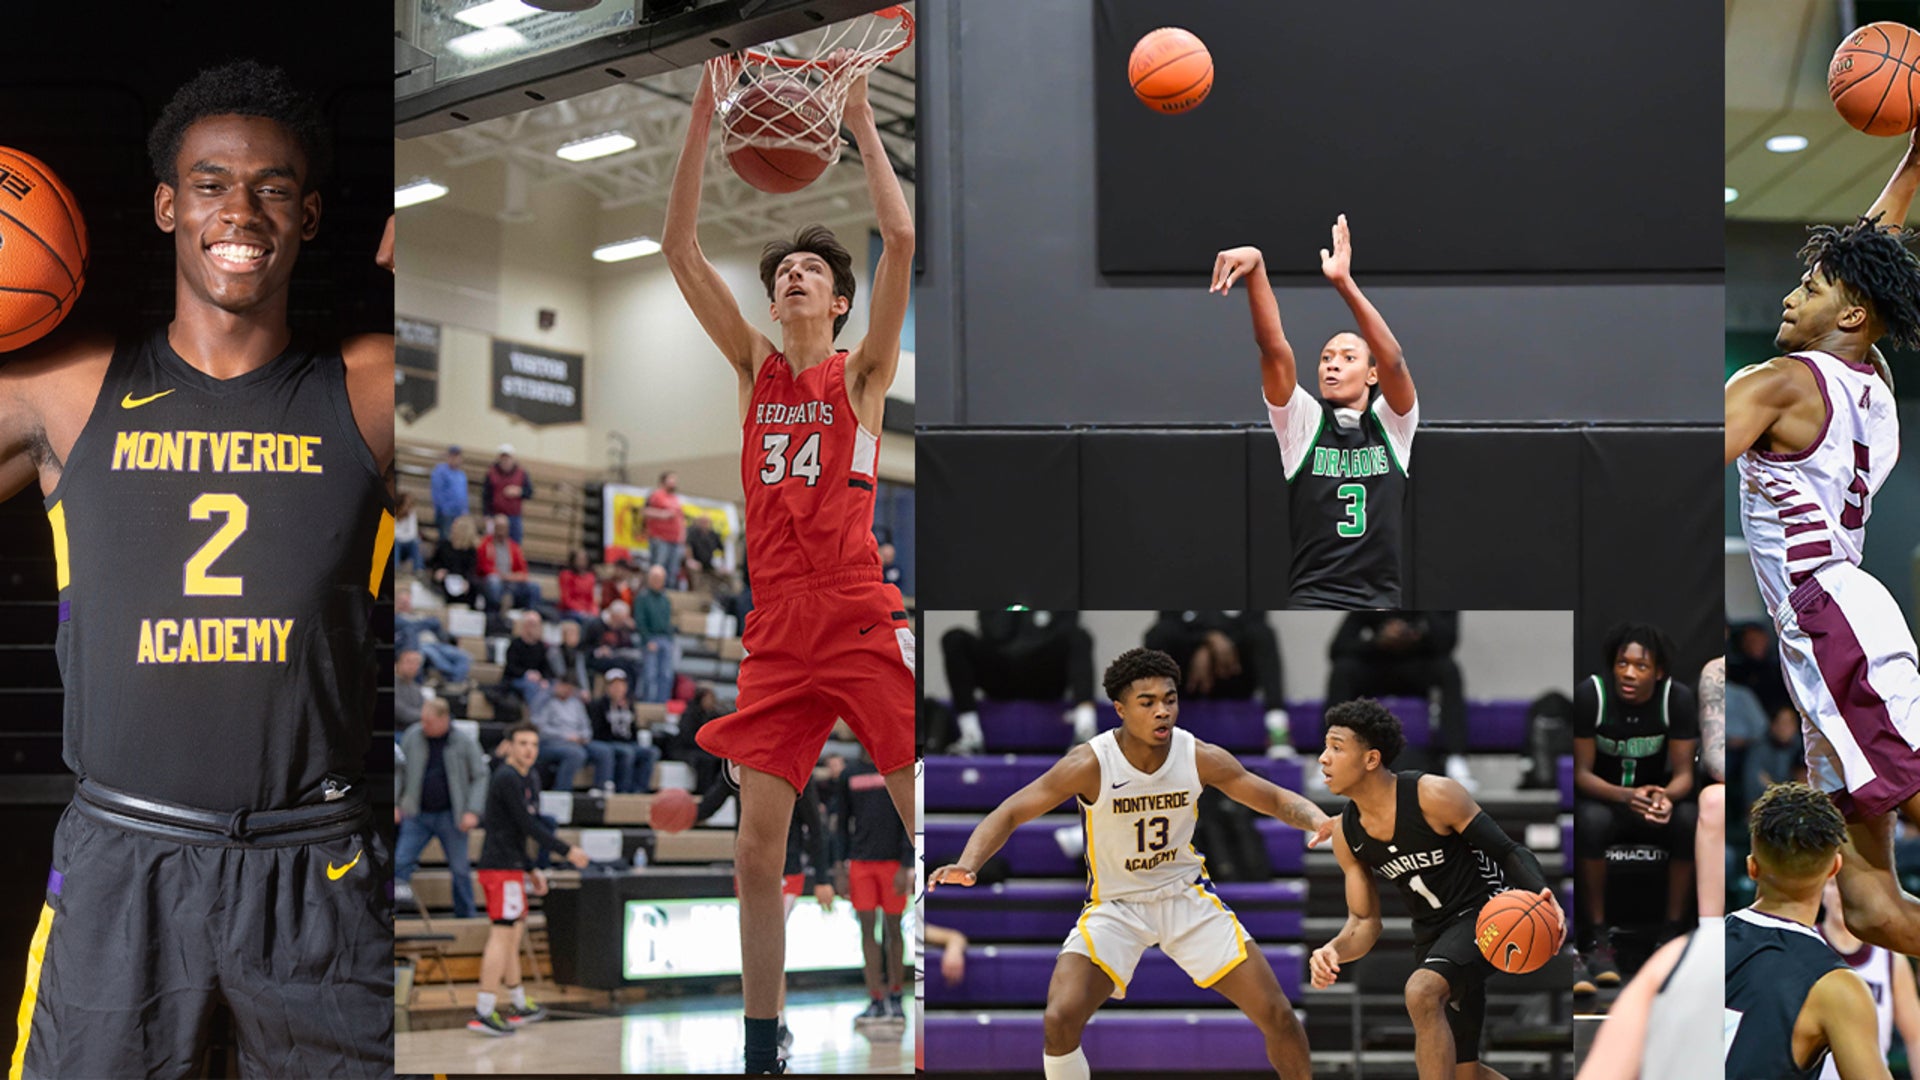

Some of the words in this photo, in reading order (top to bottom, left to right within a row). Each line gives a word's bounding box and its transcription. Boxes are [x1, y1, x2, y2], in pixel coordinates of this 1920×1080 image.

[111, 430, 323, 474] MONTVERDE
[759, 431, 822, 487] 34
[1312, 444, 1390, 478] DRAGONS
[1840, 439, 1870, 530] 5
[1336, 483, 1366, 538] 3
[182, 492, 249, 597] 2
[136, 617, 295, 664] ACADEMY
[1112, 791, 1190, 815] MONTVERDE
[1133, 816, 1170, 853] 13
[1124, 847, 1178, 872] ACADEMY
[1374, 848, 1445, 880] UNRISE
[1408, 873, 1443, 910] 1
